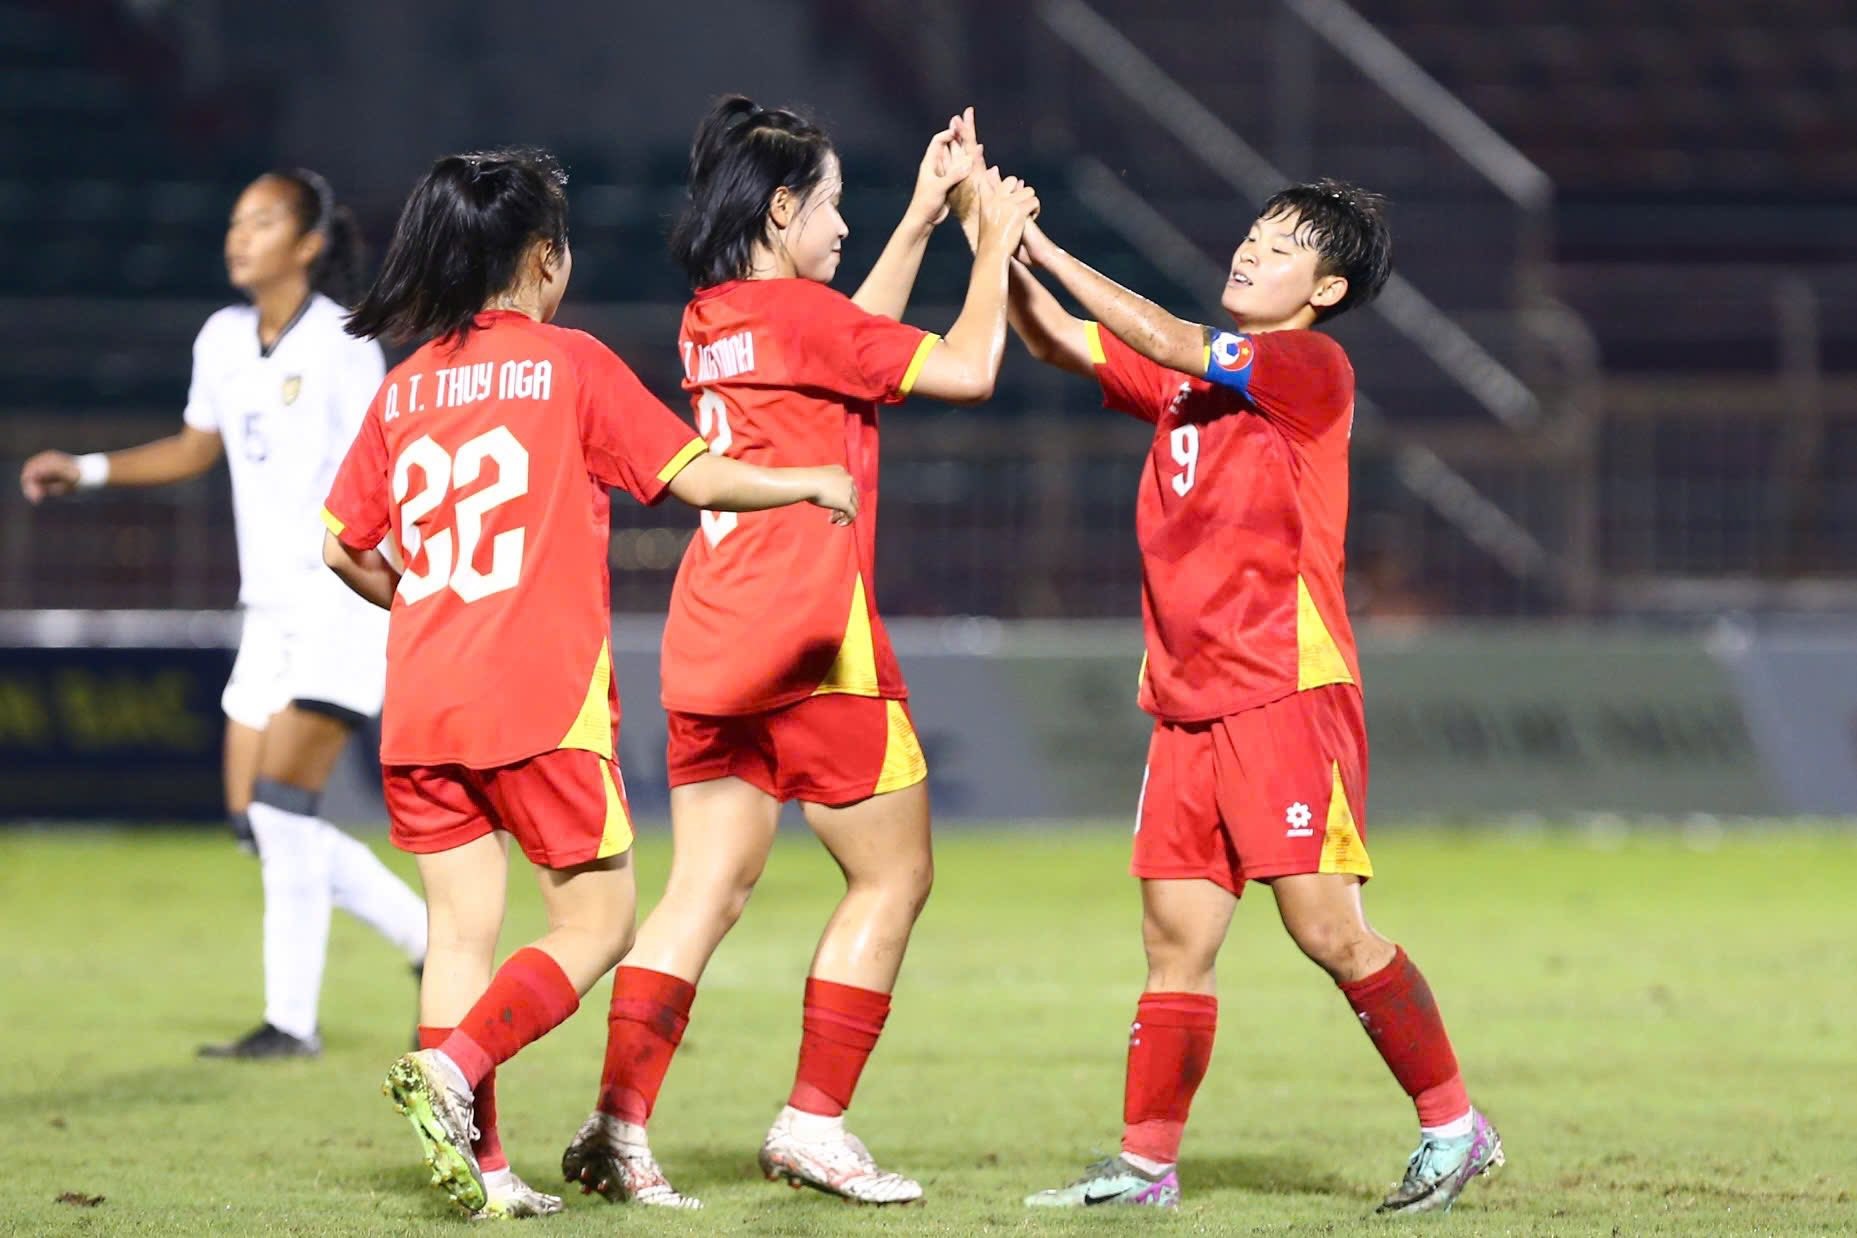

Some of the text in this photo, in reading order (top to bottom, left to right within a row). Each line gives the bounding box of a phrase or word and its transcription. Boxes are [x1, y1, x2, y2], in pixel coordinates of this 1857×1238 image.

[409, 373, 425, 413] T.
[435, 361, 495, 408] THUY
[498, 359, 553, 401] NGA
[243, 410, 269, 464] 5
[1170, 423, 1200, 498] 9
[391, 424, 529, 607] 22
